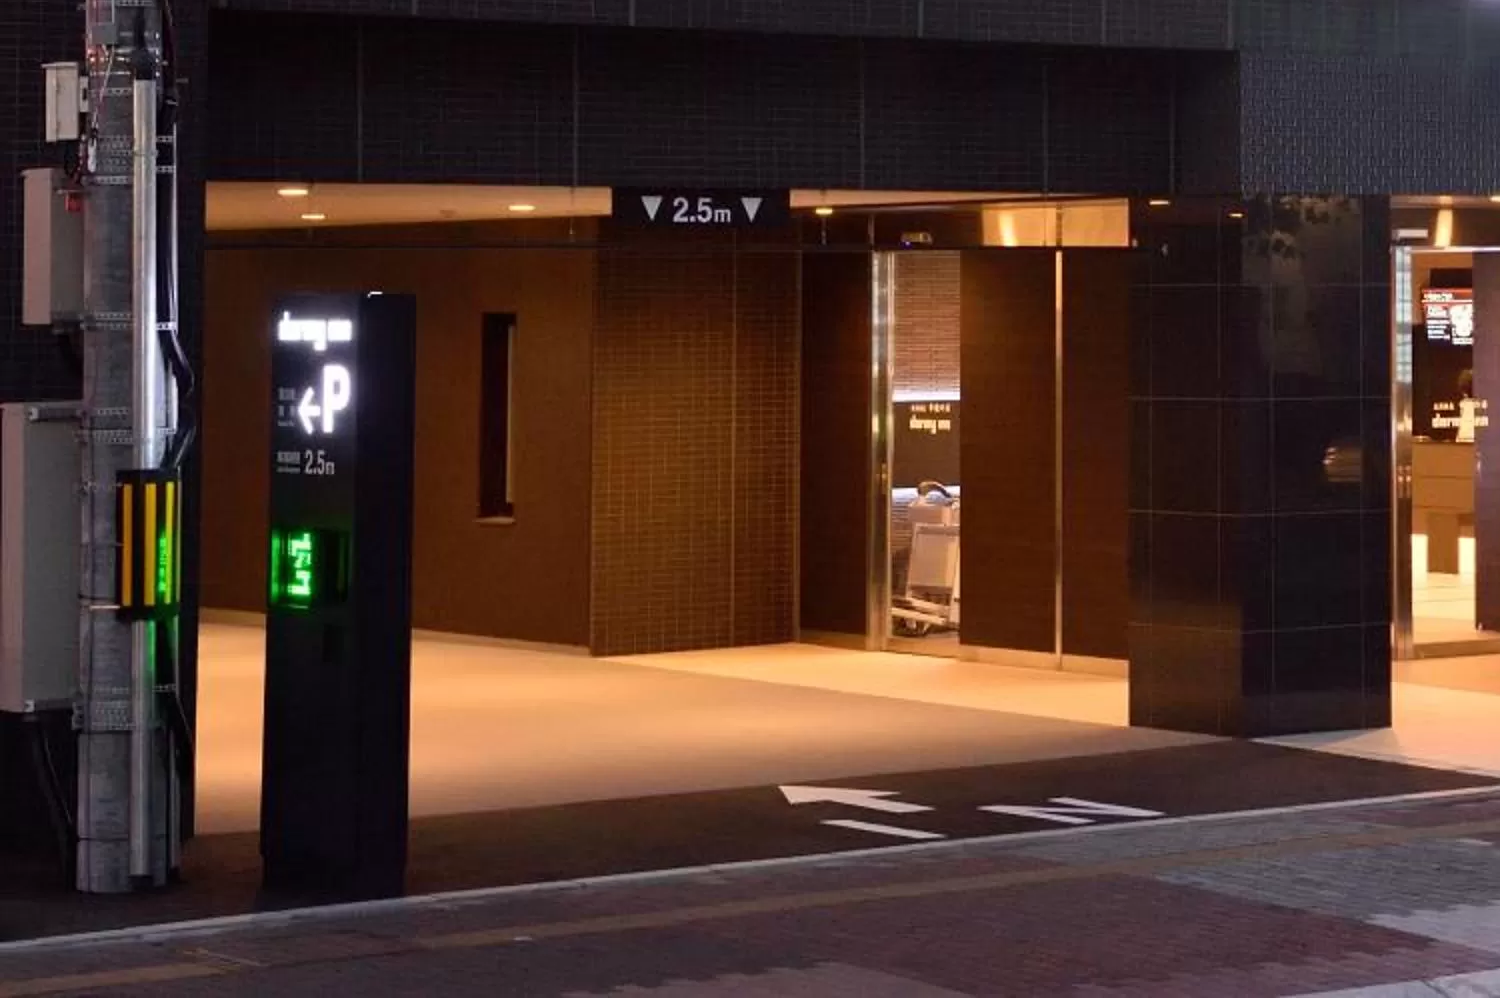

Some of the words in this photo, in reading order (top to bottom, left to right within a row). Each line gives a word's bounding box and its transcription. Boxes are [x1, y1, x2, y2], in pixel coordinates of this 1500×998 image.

[672, 196, 731, 223] 2.5m
[322, 364, 351, 434] P
[304, 450, 335, 475] 2.5m
